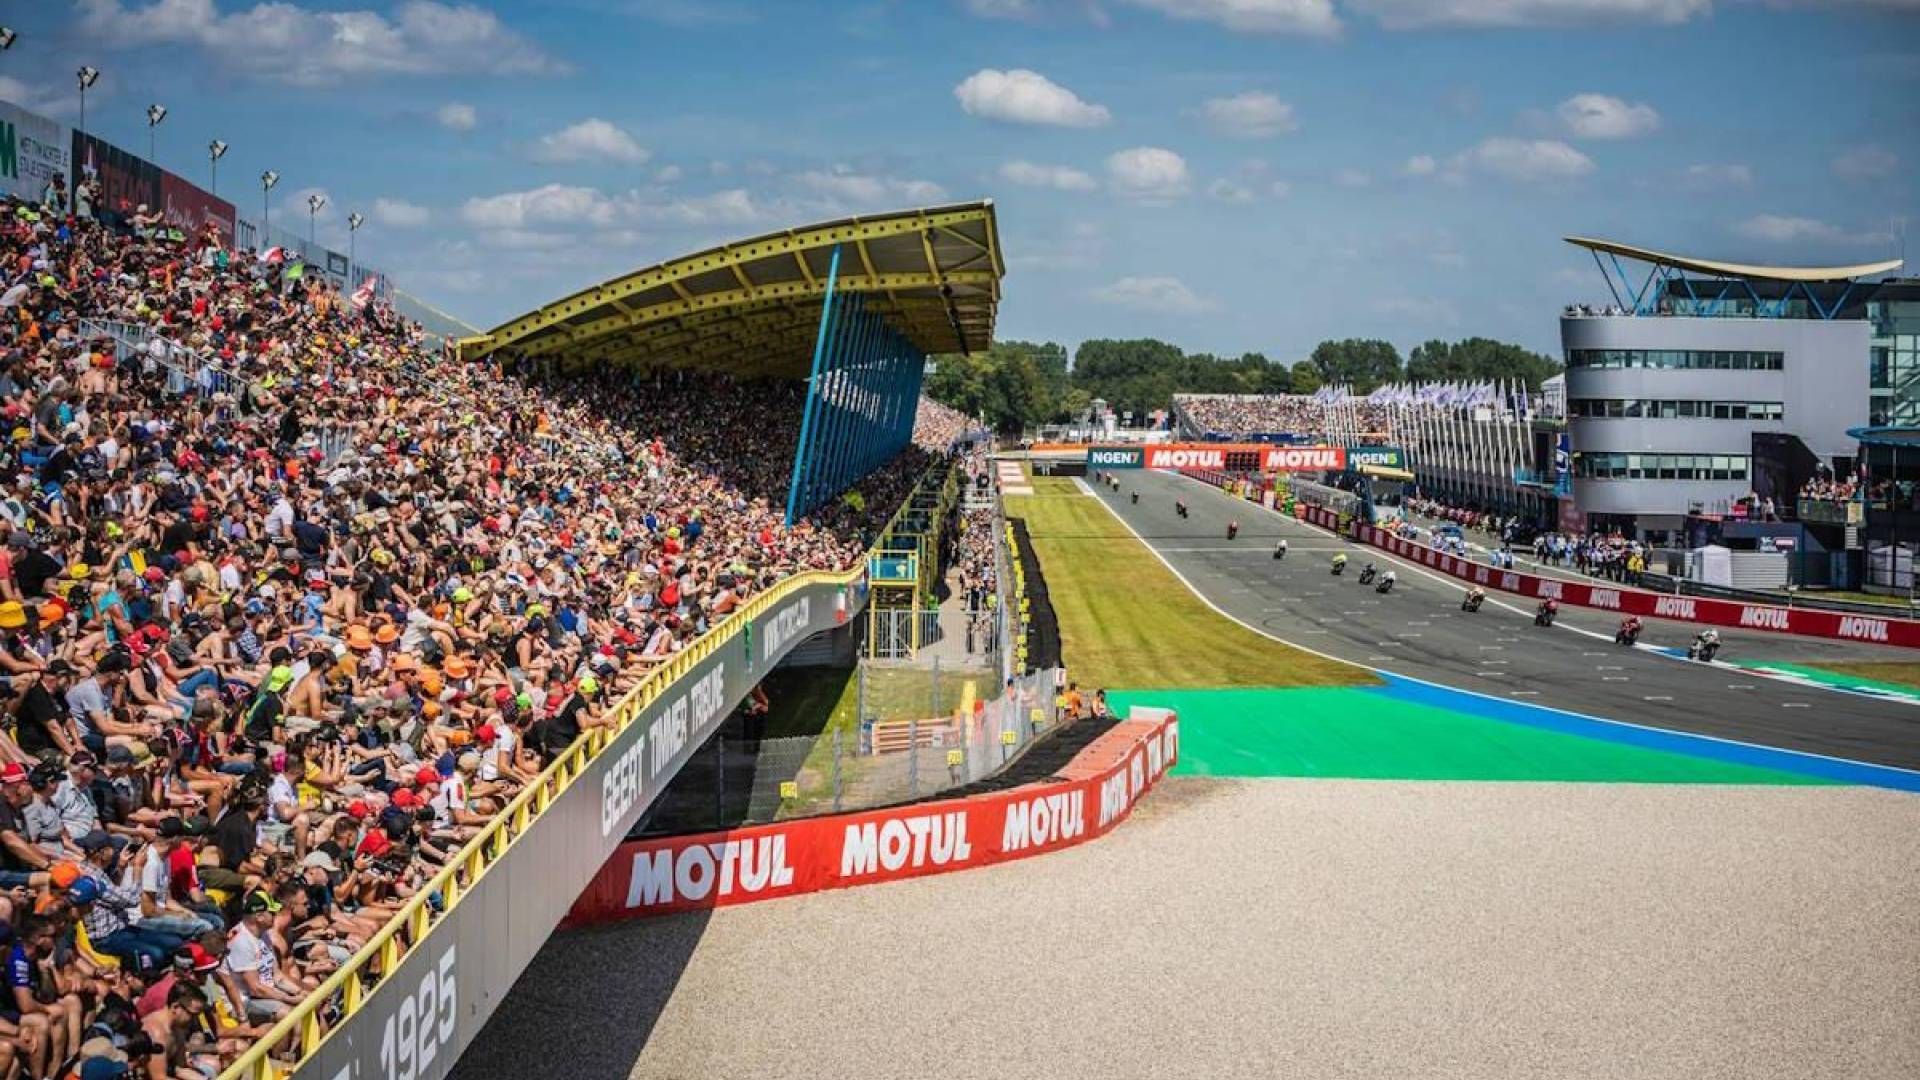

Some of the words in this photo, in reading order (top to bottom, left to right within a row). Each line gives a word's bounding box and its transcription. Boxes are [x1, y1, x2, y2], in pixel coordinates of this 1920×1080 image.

[1092, 451, 1139, 464] NGEN7
[1152, 450, 1224, 467] MOTUL
[1266, 450, 1338, 467] MOTUL
[1654, 597, 1696, 618] MOTUL
[1740, 606, 1789, 629] MOTUL
[1838, 616, 1889, 641] MOTUL
[602, 734, 645, 838] GEERT
[1002, 789, 1085, 852] MOTUL
[839, 811, 972, 877] MOTUL
[625, 833, 795, 909] MOTUL
[380, 944, 457, 1080] 1925
